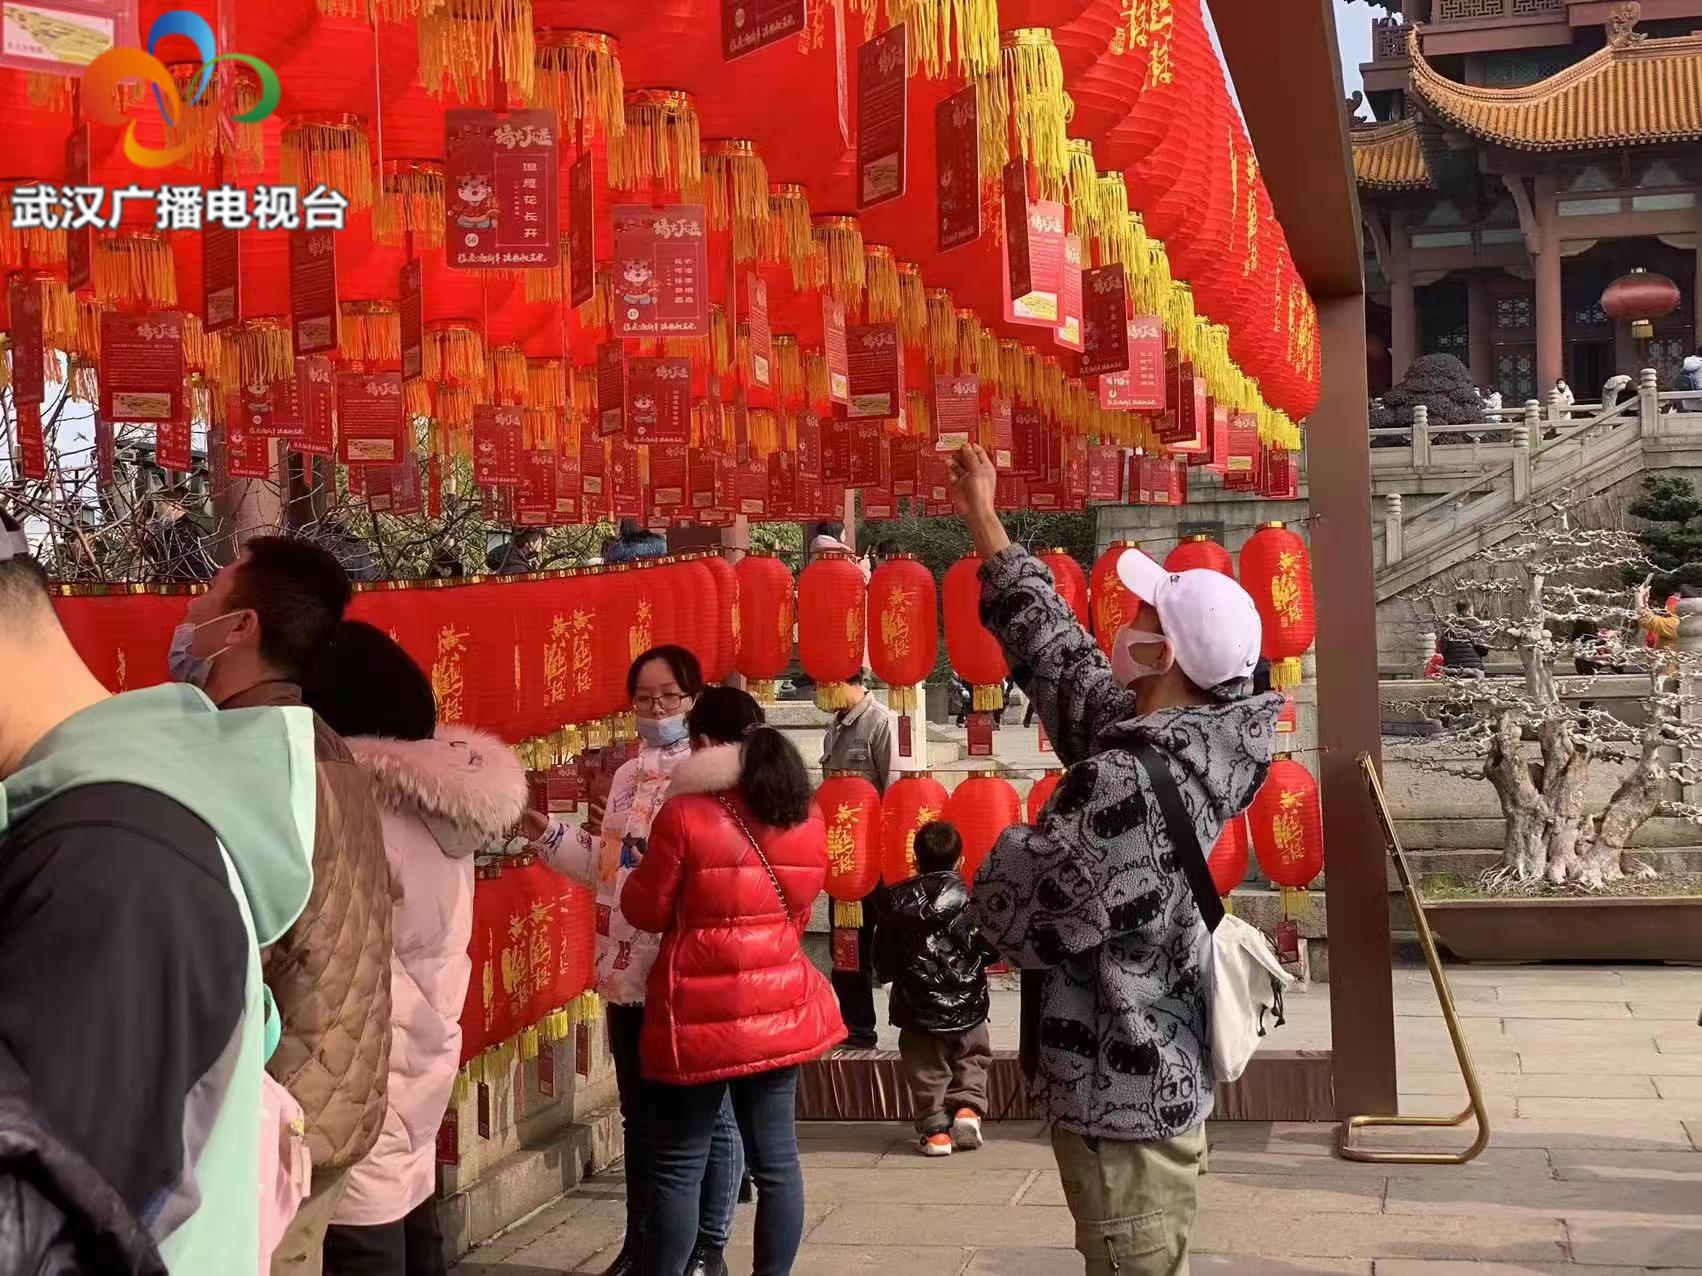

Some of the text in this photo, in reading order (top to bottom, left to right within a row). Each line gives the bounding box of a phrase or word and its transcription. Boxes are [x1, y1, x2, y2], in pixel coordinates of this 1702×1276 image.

[494, 124, 553, 149] 猜灯谜
[522, 162, 538, 238] 但愿花长开
[653, 218, 702, 239] 猜灯谜
[137, 322, 180, 341] 猜灯谜
[862, 332, 896, 349] 猜灯谜
[656, 365, 688, 379] 猜灯谜
[573, 606, 596, 693] 黄鹤楼
[529, 896, 556, 991] 黄鹤楼
